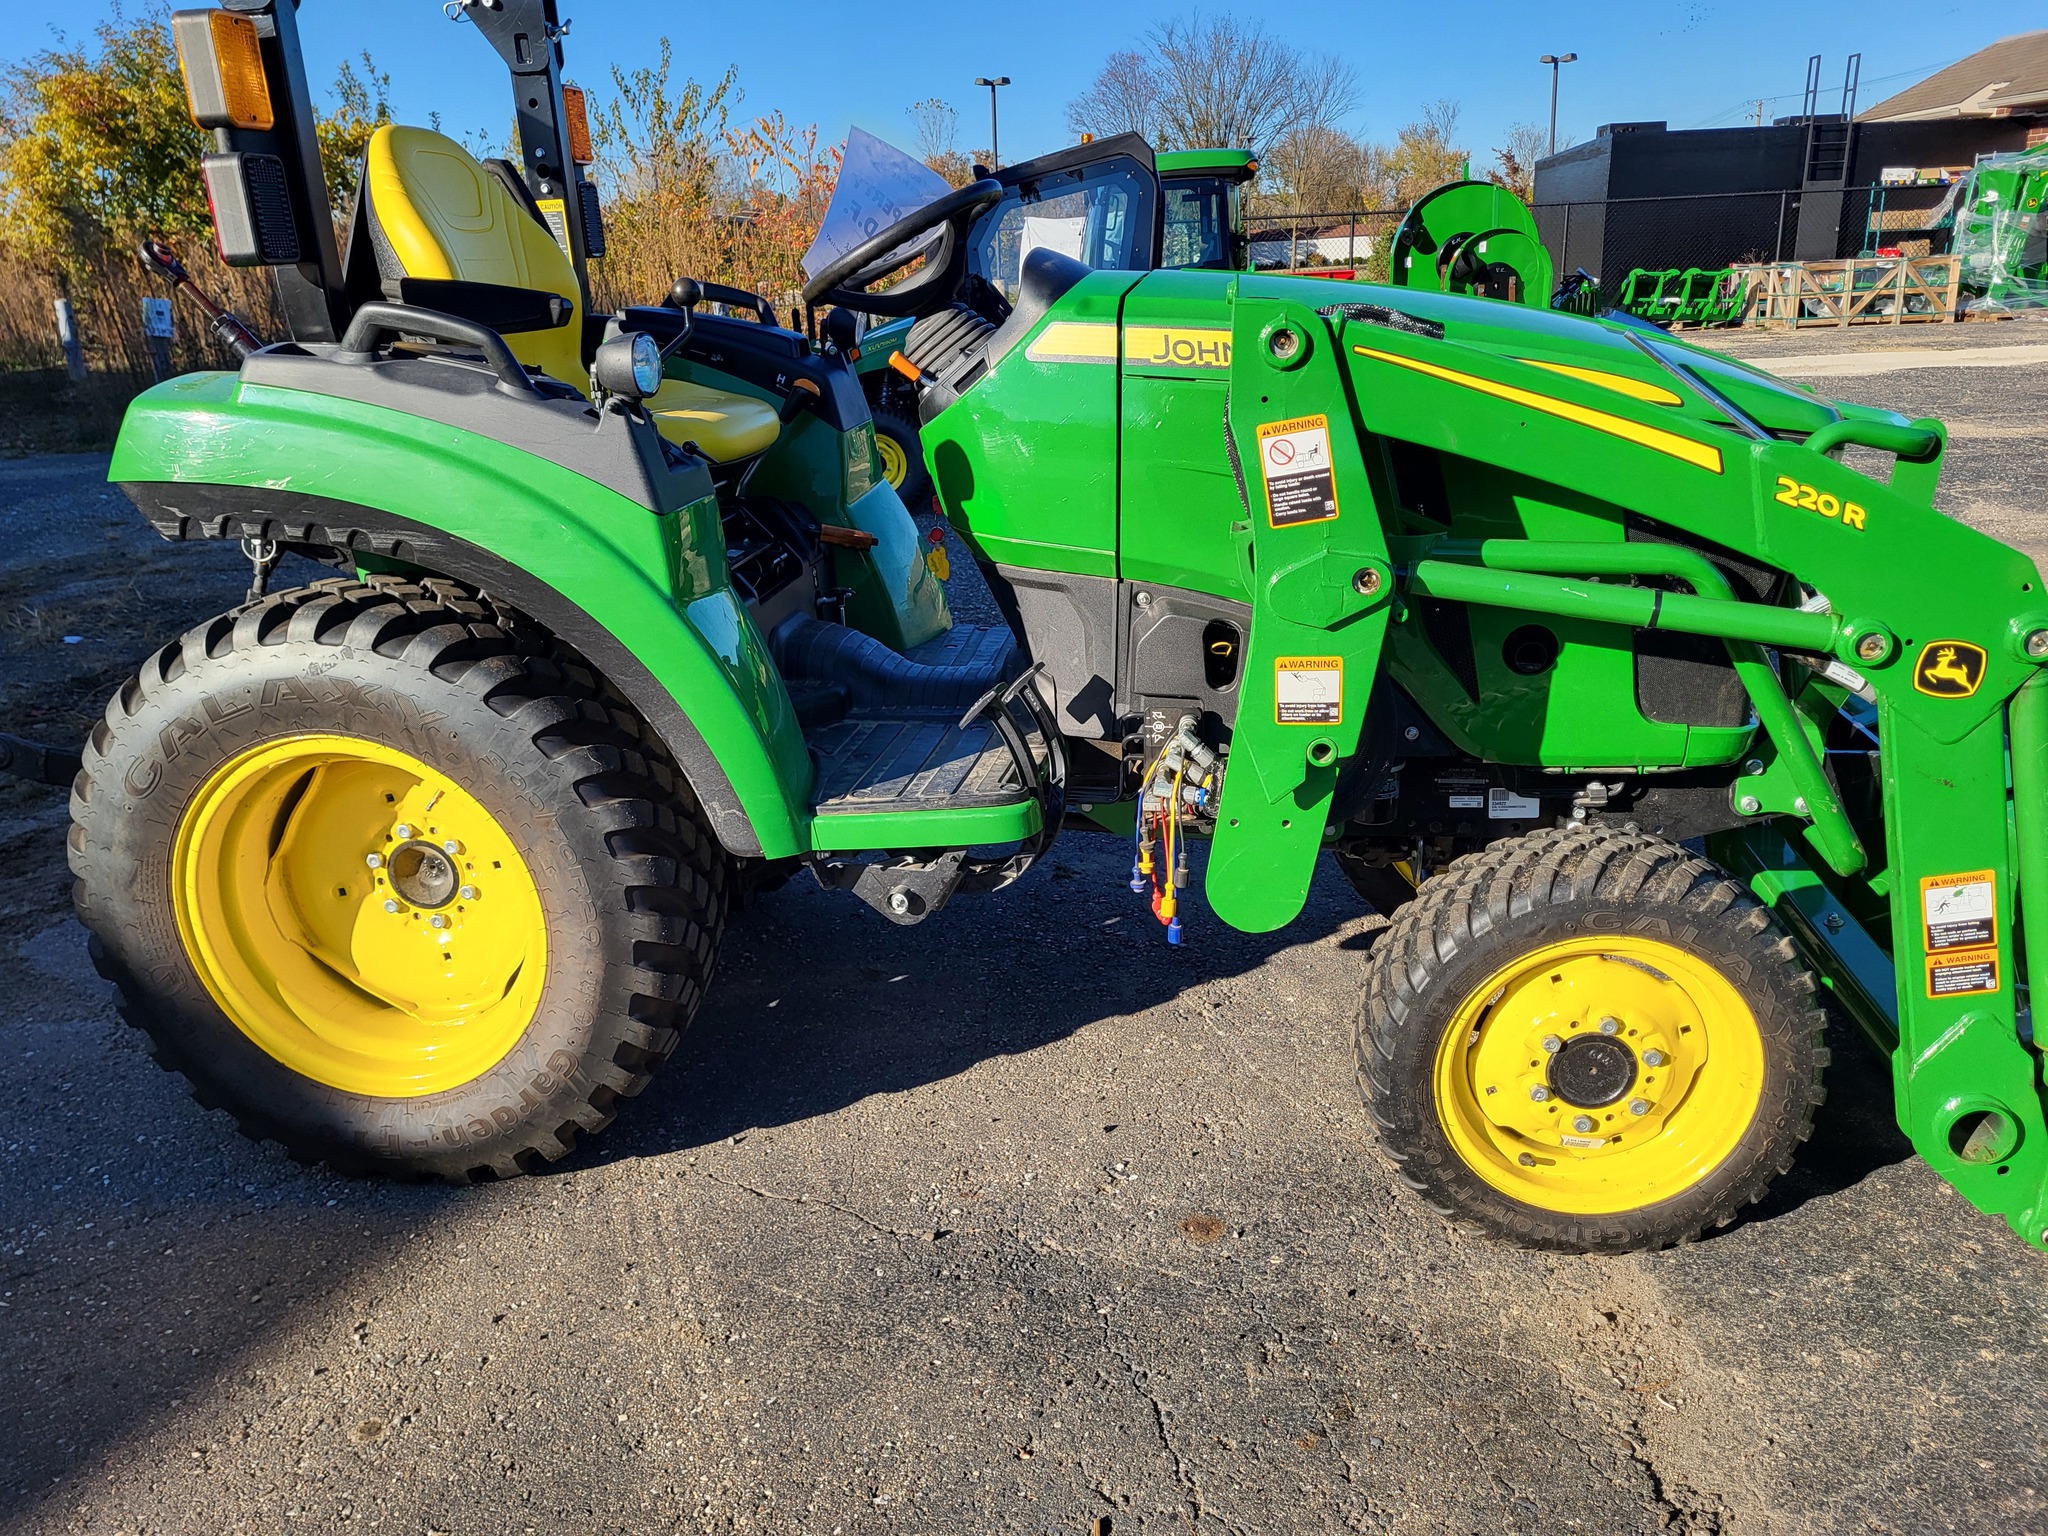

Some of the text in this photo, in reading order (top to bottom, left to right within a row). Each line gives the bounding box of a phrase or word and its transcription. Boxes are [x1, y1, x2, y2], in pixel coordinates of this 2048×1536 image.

[776, 373, 786, 385] H
[1271, 417, 1323, 435] WARNING
[1288, 660, 1338, 668] WARNING
[122, 677, 450, 800] GALAXY
[1941, 874, 1986, 886] WARNING
[1946, 952, 1990, 964] WARNING
[1581, 909, 1798, 1056] GALAXY
